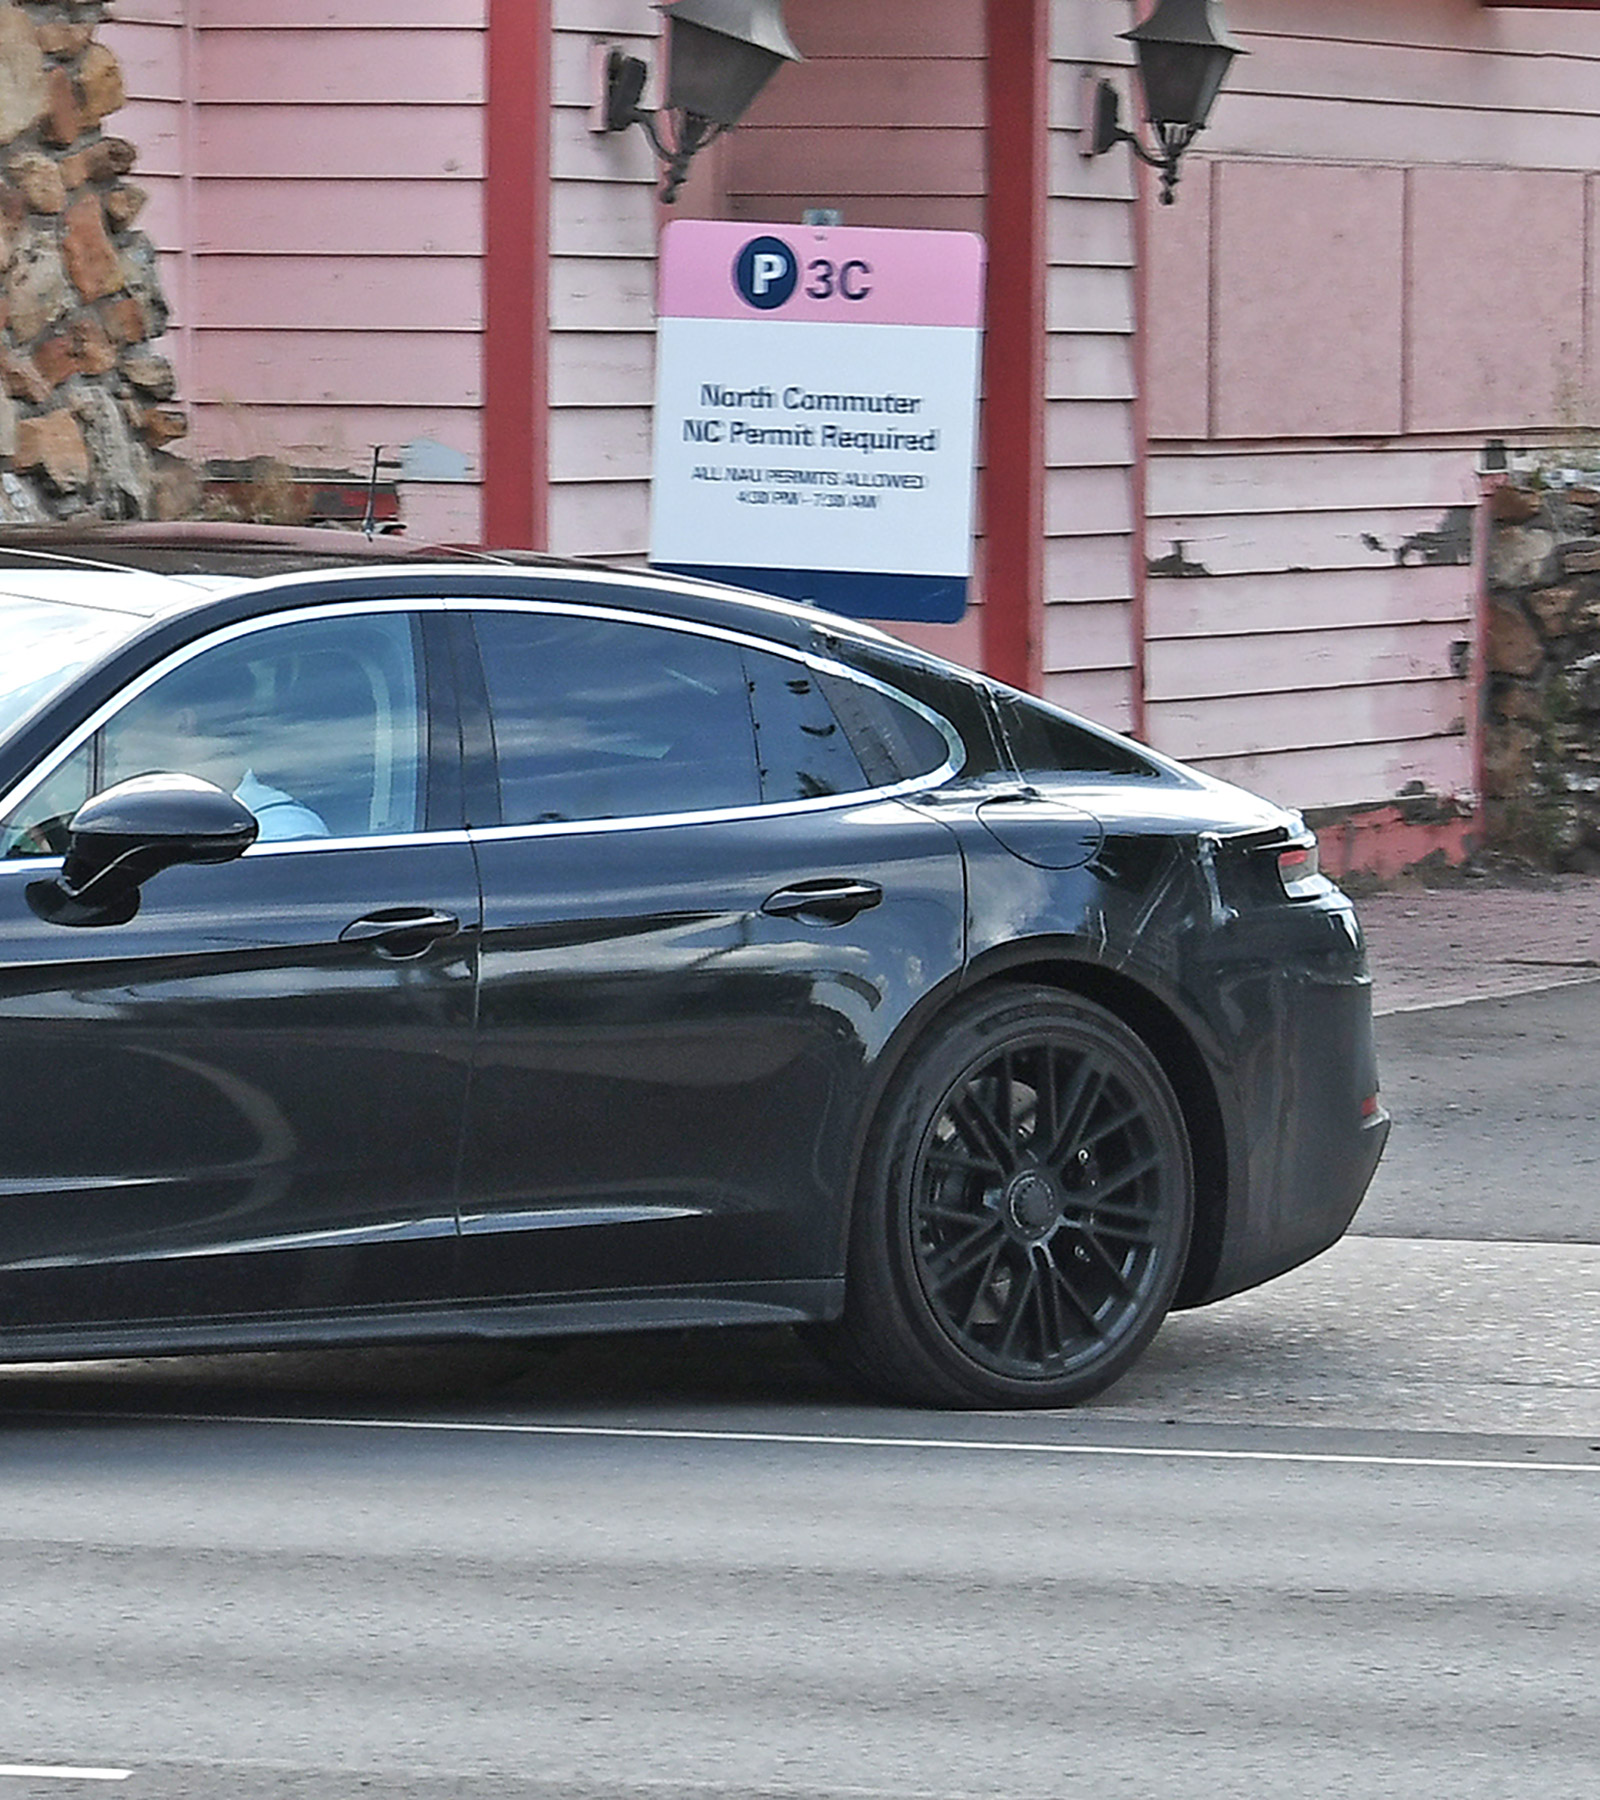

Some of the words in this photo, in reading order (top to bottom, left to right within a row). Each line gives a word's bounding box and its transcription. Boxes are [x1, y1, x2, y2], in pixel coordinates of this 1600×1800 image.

[752, 253, 788, 294] P
[805, 259, 872, 301] 3C
[700, 384, 775, 409] North
[783, 387, 921, 414] Commuter
[683, 419, 722, 443] NC
[730, 421, 814, 447] Permit
[821, 425, 938, 454] Required
[692, 467, 721, 481] ALL
[766, 469, 838, 486] PERMITS
[843, 473, 925, 489] ALLOWED
[773, 491, 799, 506] PM
[851, 494, 878, 509] AM
